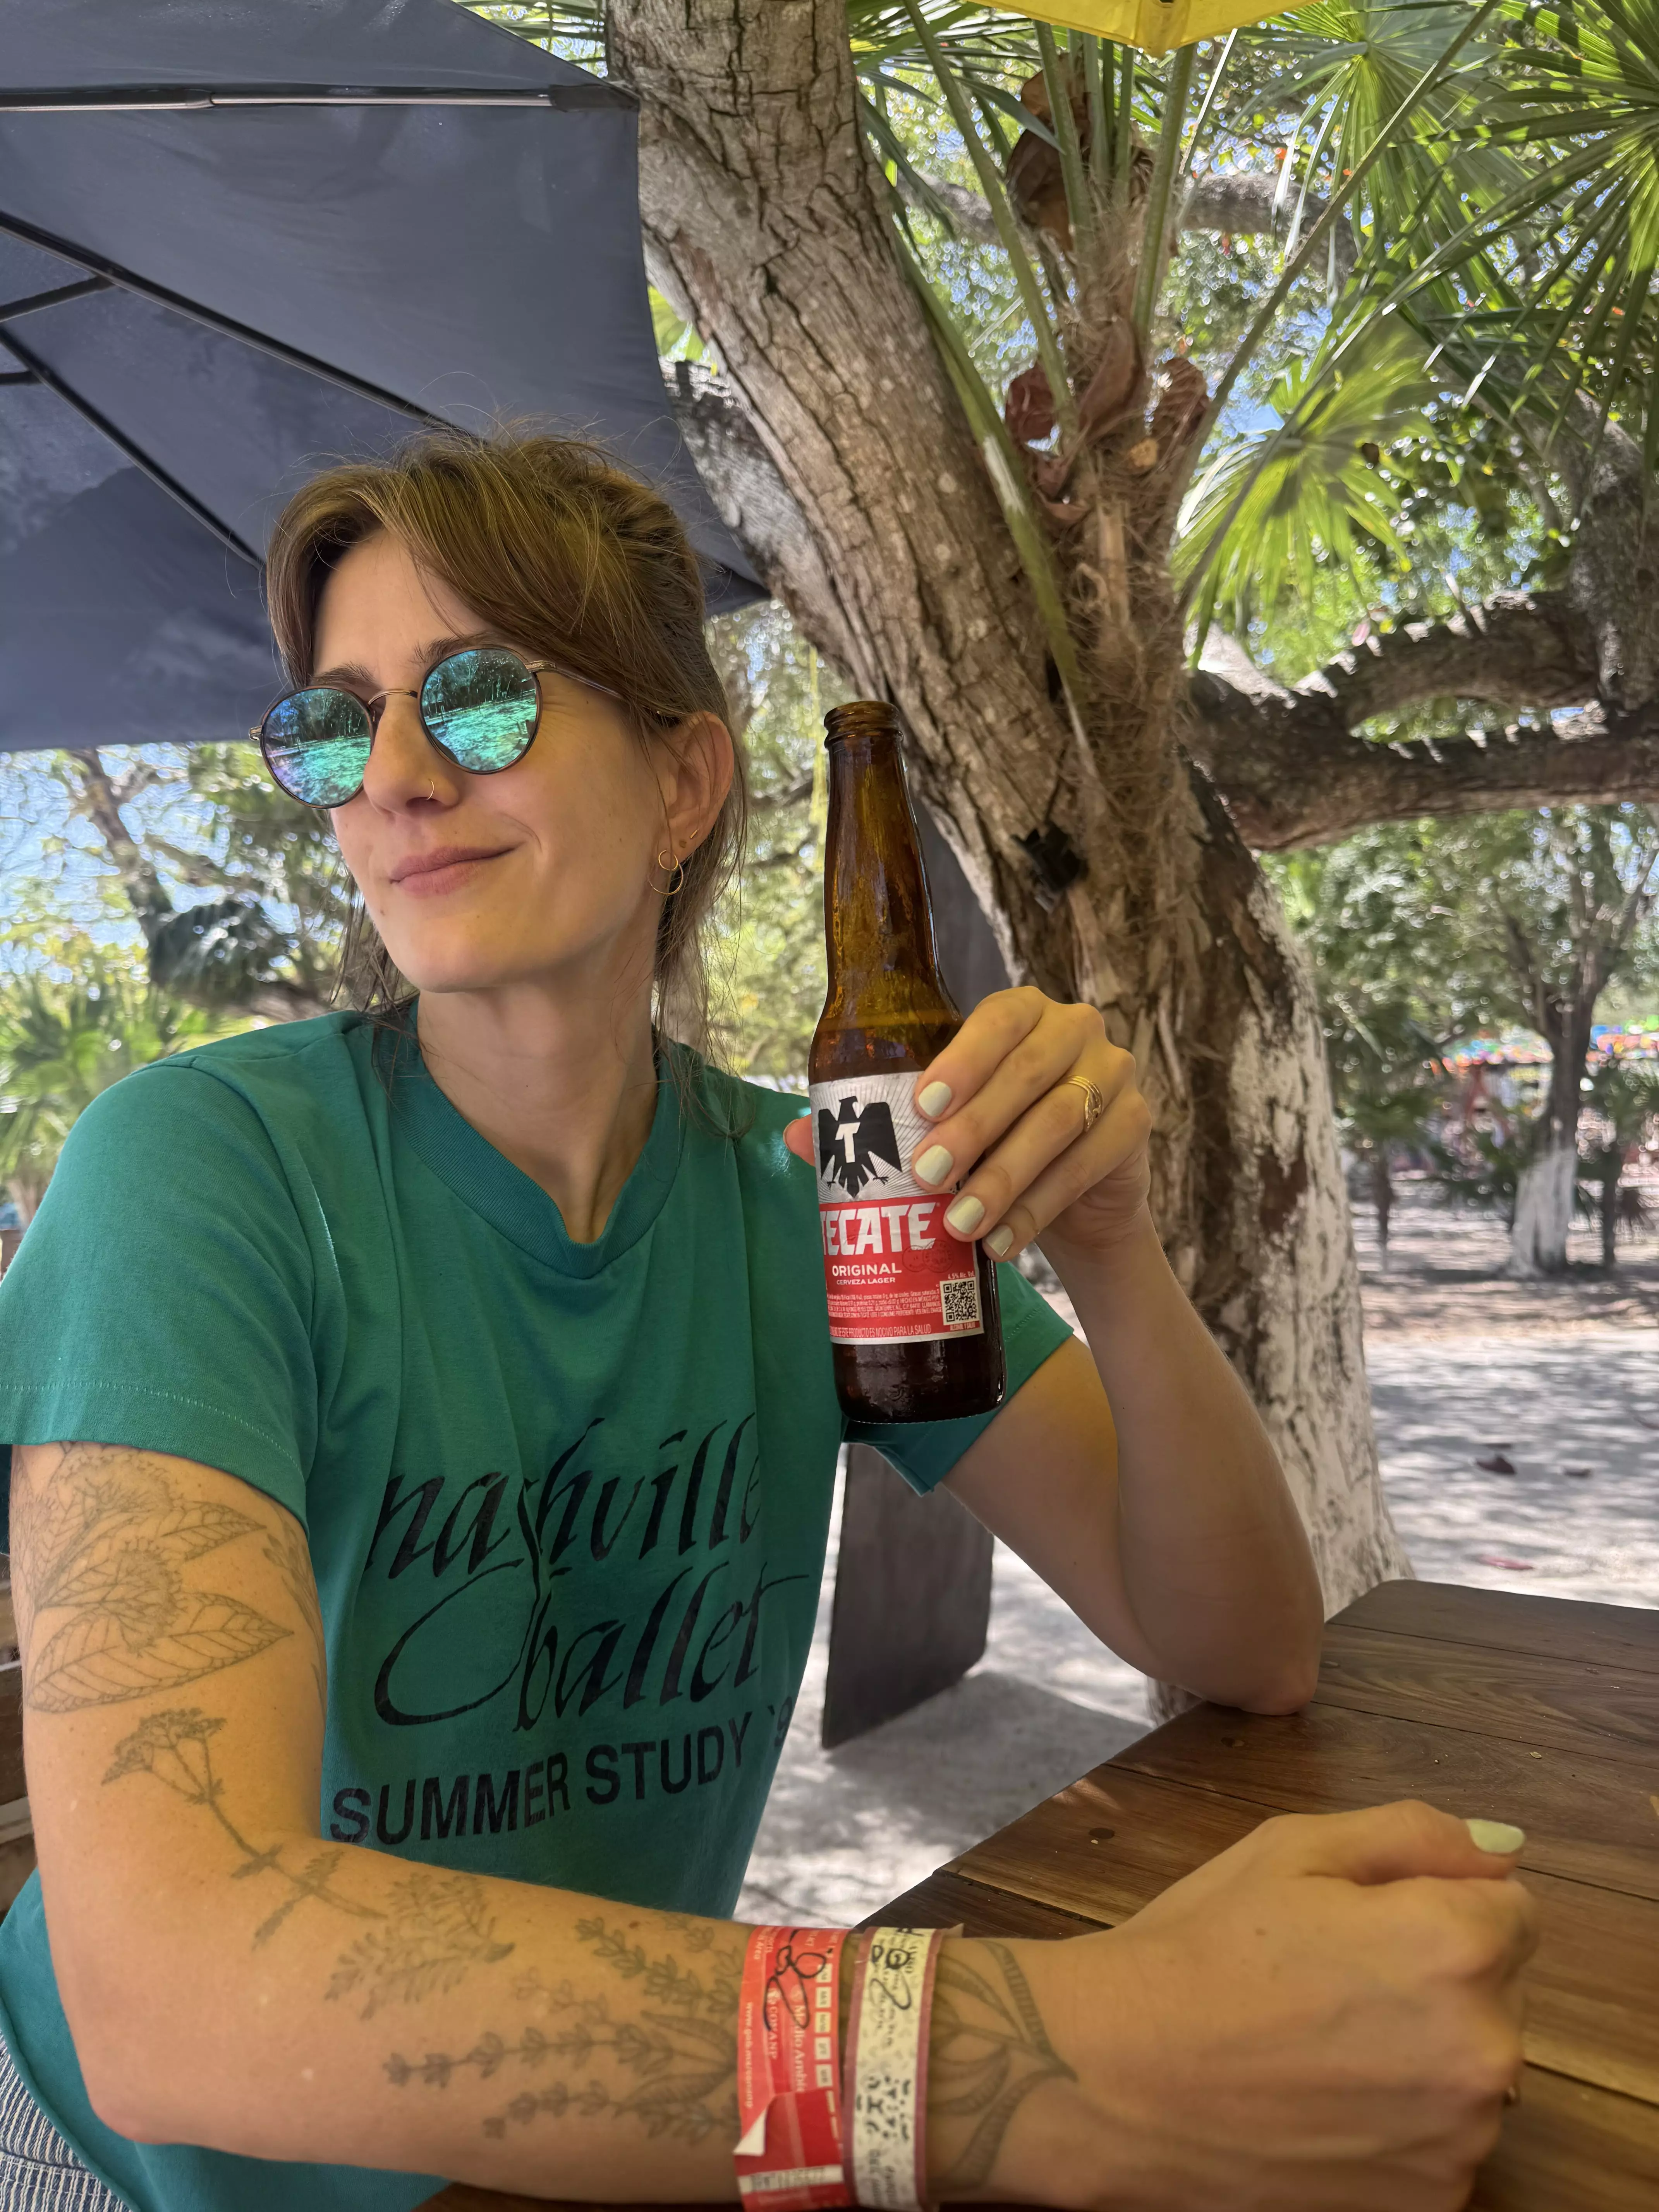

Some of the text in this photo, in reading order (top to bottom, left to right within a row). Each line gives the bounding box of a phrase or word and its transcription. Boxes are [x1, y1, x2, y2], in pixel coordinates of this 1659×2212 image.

[835, 1122, 861, 1163] T
[832, 1262, 902, 1277] ORIGINAL
[869, 1328, 875, 1337] ES
[893, 1326, 907, 1336] PARA
[907, 1325, 914, 1335] LA
[914, 1324, 931, 1334] SALUD
[364, 1412, 761, 1580] nashville
[374, 1558, 809, 1733] ballet
[329, 1752, 570, 1845] SUMMER
[585, 1711, 753, 1805] STUDY
